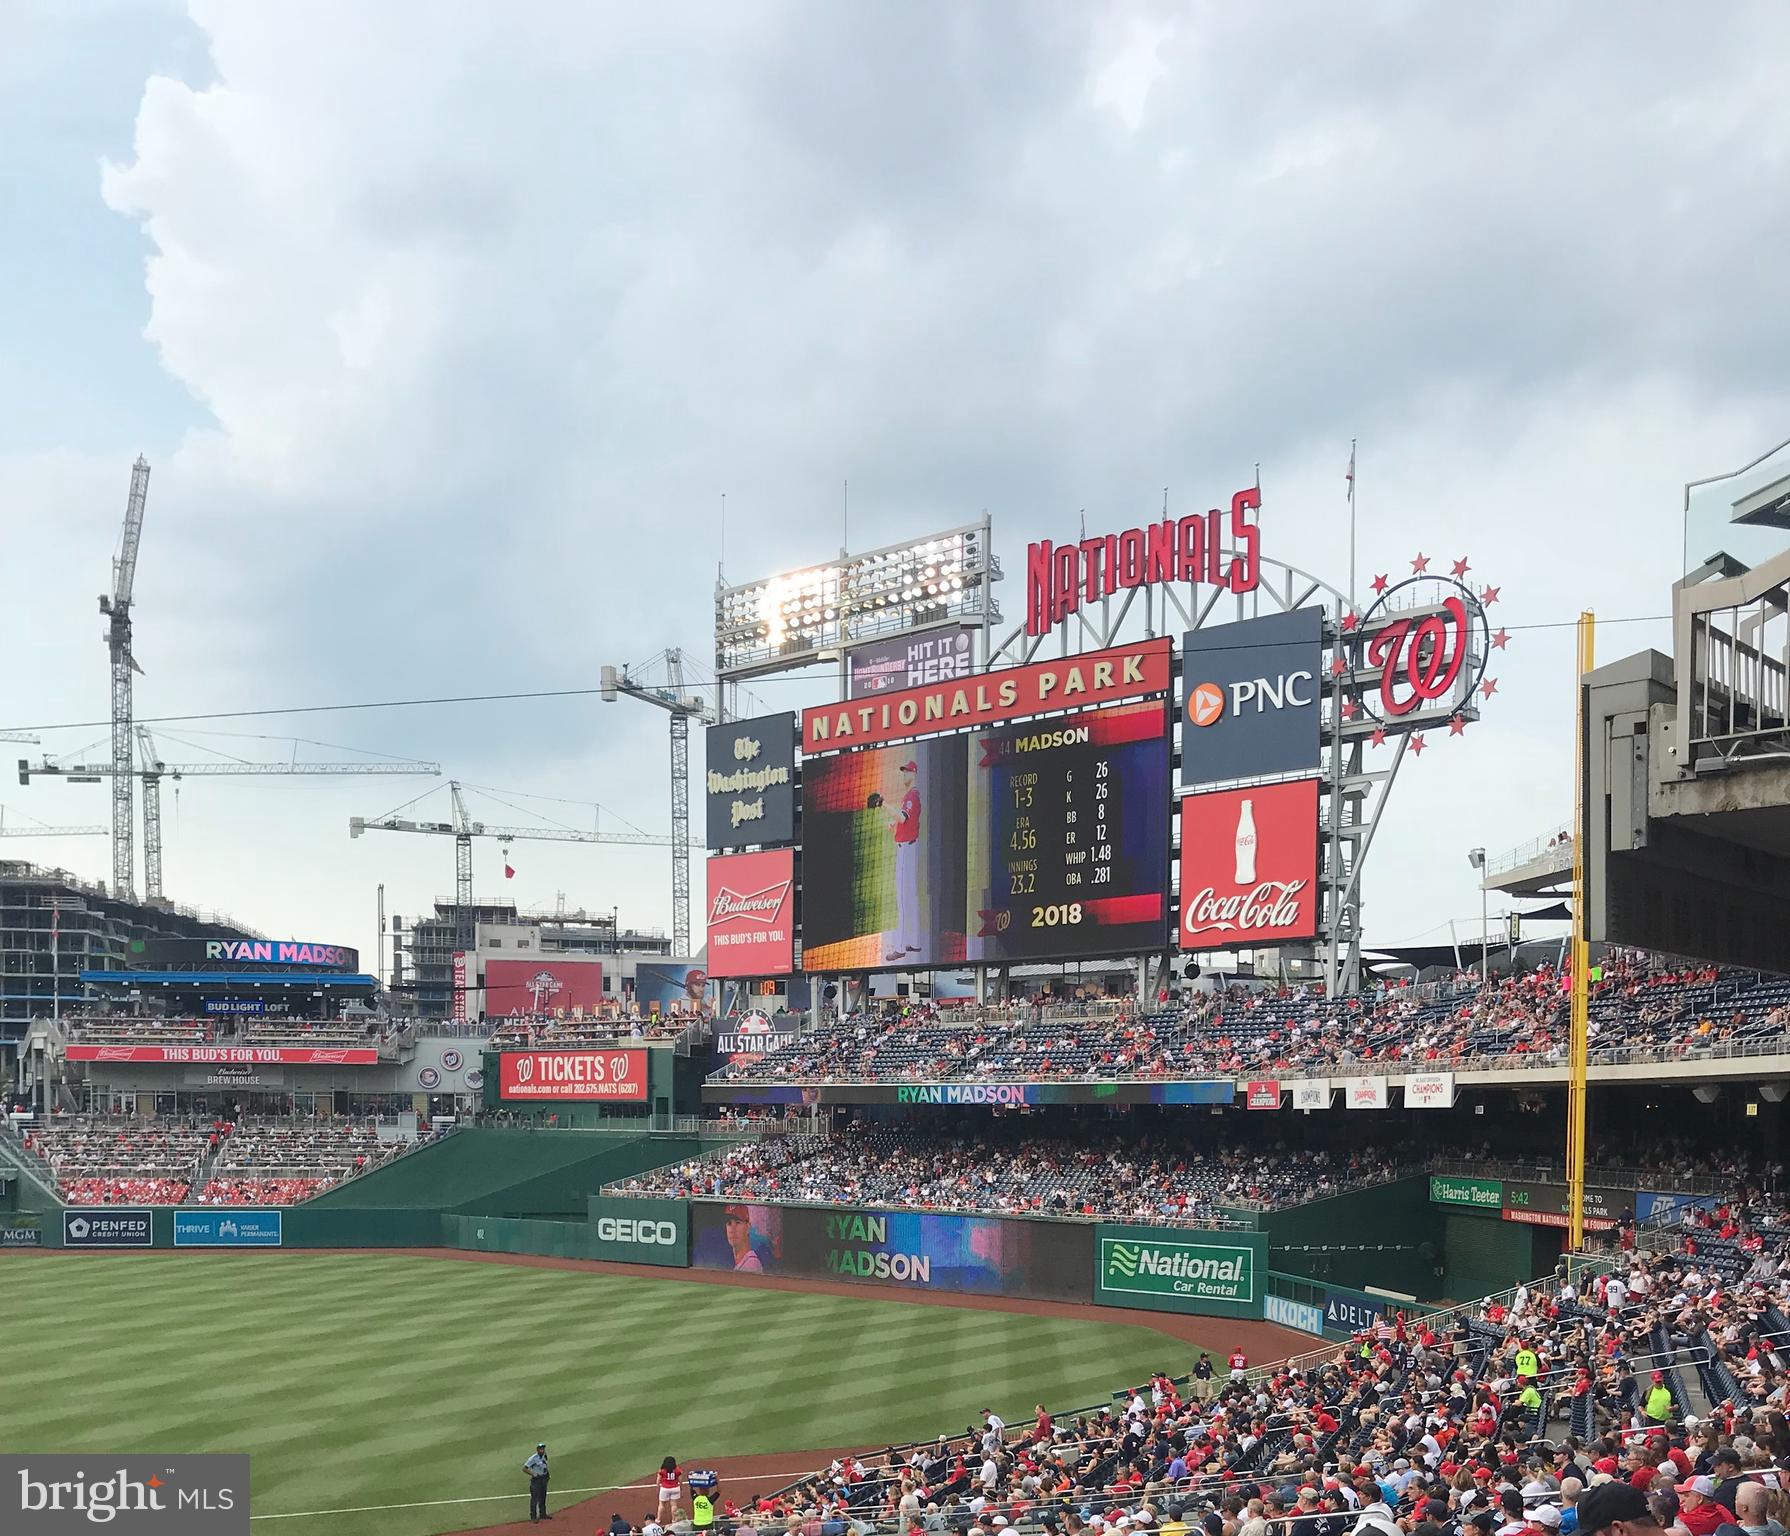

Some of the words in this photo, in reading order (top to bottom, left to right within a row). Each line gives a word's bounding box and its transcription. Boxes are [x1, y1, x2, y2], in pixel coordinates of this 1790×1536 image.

[1027, 488, 1261, 636] NATIONALS
[908, 641, 934, 662] HIT
[938, 637, 953, 655] IT
[1368, 596, 1467, 716] W
[908, 652, 970, 687] HERE
[812, 680, 1018, 740] NATIONALS
[1039, 654, 1145, 700] PARK
[1229, 670, 1312, 717] PNC
[734, 736, 761, 762] The
[1015, 727, 1089, 754] MADSON
[708, 765, 790, 794] Washington
[1010, 772, 1038, 788] RECORD
[1067, 770, 1073, 783] G
[1096, 761, 1108, 779] 26
[1014, 788, 1033, 808] 1-3
[1066, 791, 1072, 803] K
[1096, 782, 1108, 800] 26
[730, 797, 765, 828] Post
[1067, 811, 1077, 823] BB
[1098, 803, 1105, 820] 8
[1016, 817, 1030, 829] ERA
[1010, 829, 1036, 851] 4.56
[1066, 832, 1076, 844] ER
[1096, 824, 1107, 841] 12
[1066, 851, 1086, 865] WHIP
[1090, 844, 1111, 863] 1.48
[1008, 859, 1038, 874] INNINGS
[1066, 873, 1082, 885] OBA
[1090, 866, 1111, 884] .281
[1010, 874, 1035, 895] 23.2
[714, 894, 783, 916] Budweiser
[1185, 878, 1309, 934] Coca-Cola
[1031, 903, 1082, 928] 2018
[714, 935, 729, 946] THIS
[730, 933, 752, 945] BUD'S
[753, 932, 767, 943] FOR
[768, 930, 785, 942] YOU.
[206, 941, 272, 960] RYAN
[279, 943, 353, 965] MADSON
[207, 1003, 230, 1011] BUD
[231, 1003, 261, 1012] LIGHT
[265, 1004, 290, 1012] LOFT
[717, 1036, 735, 1053] ALL
[737, 1035, 763, 1053] STAR
[162, 1048, 190, 1060] THIS
[193, 1048, 228, 1060] BUD'S
[230, 1048, 253, 1060] FOR
[256, 1048, 283, 1061] YOU.
[538, 1056, 605, 1081] TICKETS
[207, 1076, 231, 1085] BREW
[232, 1076, 260, 1085] HOUSE
[508, 1084, 551, 1094] nationals.com
[560, 1084, 573, 1094] call
[574, 1083, 617, 1094] 202.675.NATS
[618, 1083, 638, 1095] (6287)
[1413, 1083, 1443, 1094] CHAMPIONS
[898, 1085, 941, 1103] RYAN
[947, 1085, 1025, 1103] MADSON
[1442, 1184, 1469, 1200] Harris
[1471, 1186, 1499, 1203] Teeter
[1511, 1191, 1528, 1205] 5:42
[1595, 1195, 1602, 1204] TO
[1511, 1211, 1541, 1222] WASHINGTON
[1542, 1214, 1569, 1225] NATIONALS
[1593, 1207, 1608, 1216] PARK
[4, 1230, 36, 1239] MGM
[93, 1220, 146, 1230] PENFED
[177, 1225, 210, 1233] THRIVE
[598, 1217, 676, 1246] GEICO
[1138, 1249, 1243, 1281] National
[1173, 1281, 1194, 1292] Car
[1197, 1282, 1238, 1296] Rental
[1519, 1356, 1530, 1366] 77
